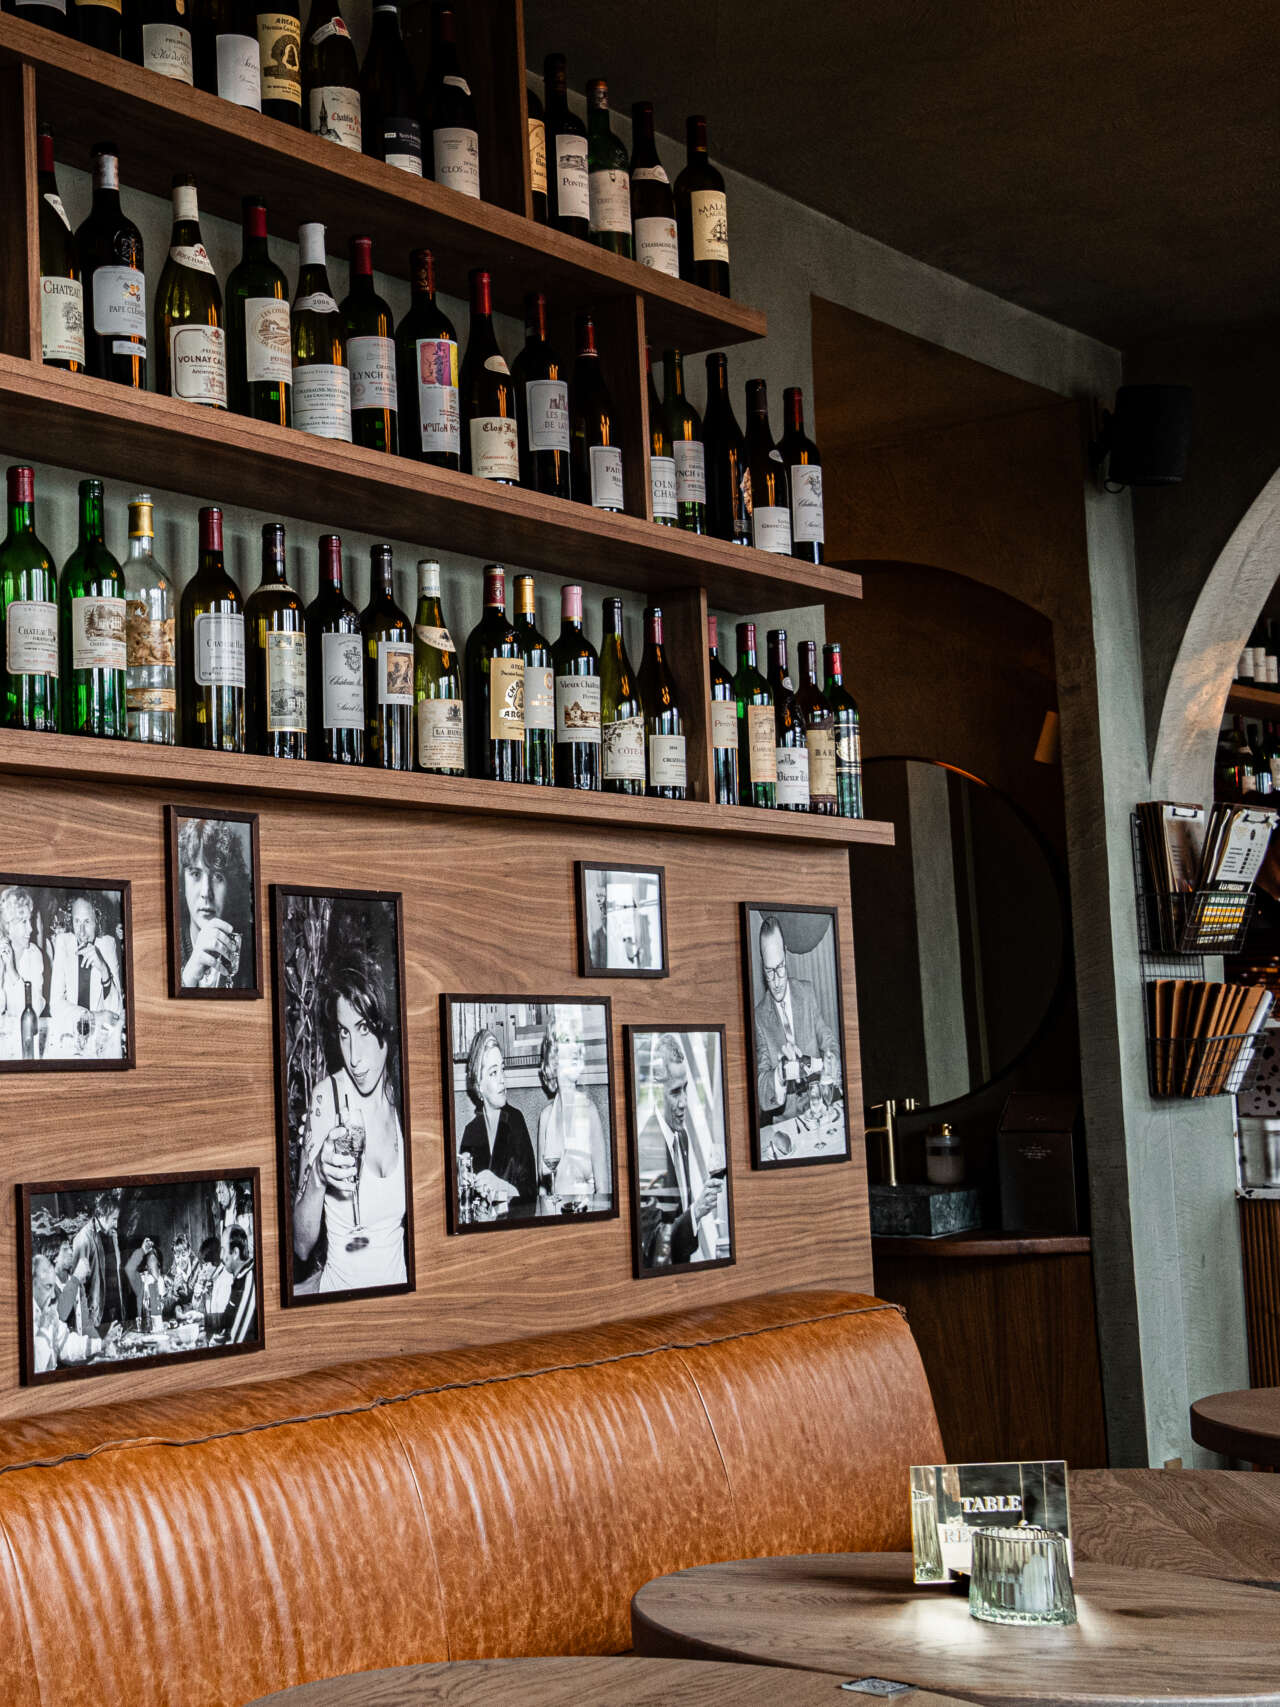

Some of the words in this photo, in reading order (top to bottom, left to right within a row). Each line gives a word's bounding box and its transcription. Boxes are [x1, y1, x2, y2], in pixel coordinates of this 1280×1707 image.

[331, 112, 354, 123] Chablis
[441, 166, 463, 175] CLOS
[178, 355, 211, 364] VOLNAY
[352, 370, 384, 380] LYNCH
[546, 411, 558, 419] LES
[482, 423, 503, 433] Clos
[544, 421, 555, 429] DE
[560, 680, 579, 689] Vieux
[960, 1495, 1022, 1513] TABLE
